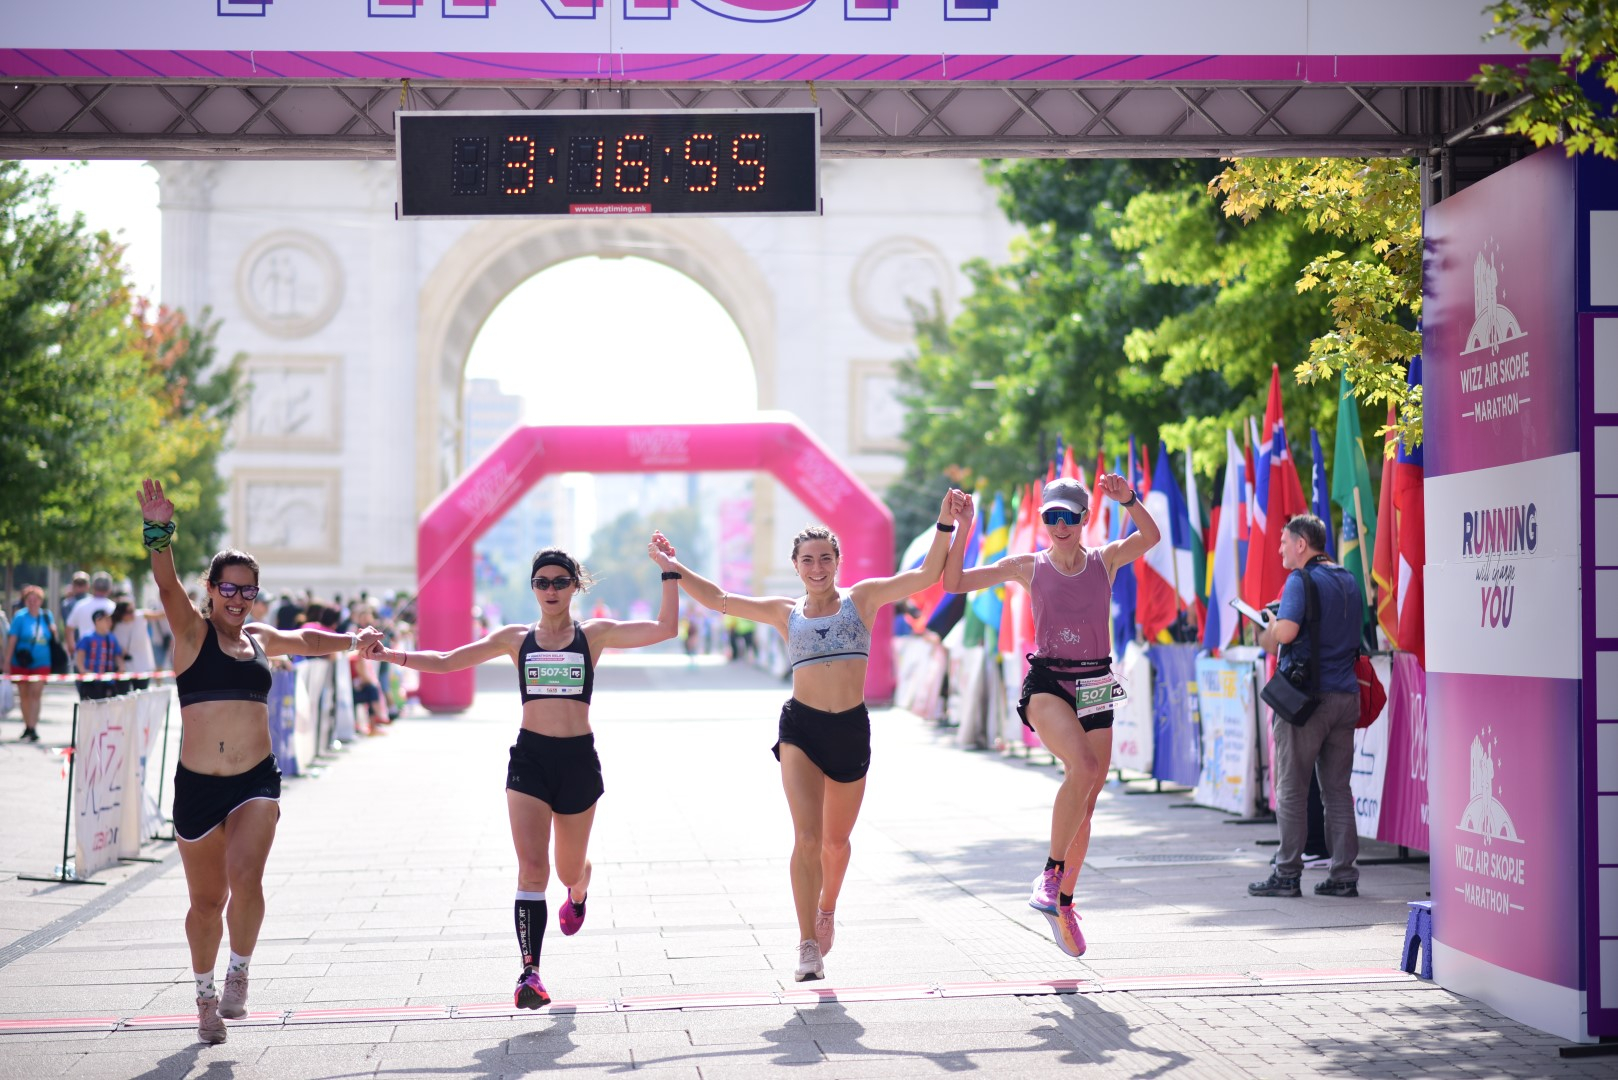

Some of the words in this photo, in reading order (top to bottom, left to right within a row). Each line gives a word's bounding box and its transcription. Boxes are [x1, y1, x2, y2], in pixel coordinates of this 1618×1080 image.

[506, 133, 765, 195] 3:16:55
[574, 204, 647, 214] www.tagtiming.mk
[1460, 366, 1483, 394] WIZZ
[1484, 361, 1499, 388] AIR
[1500, 351, 1530, 384] SKOPJE
[1474, 392, 1519, 423] MARATHON
[1462, 502, 1538, 558] RUNNING
[1481, 585, 1515, 628] YOU
[540, 667, 569, 677] 507-3
[1081, 687, 1107, 702] 507
[1455, 843, 1474, 872] WIZZ
[1475, 849, 1489, 876] AIR
[1490, 853, 1525, 885] SKOPJE
[1464, 882, 1509, 915] MARATHON
